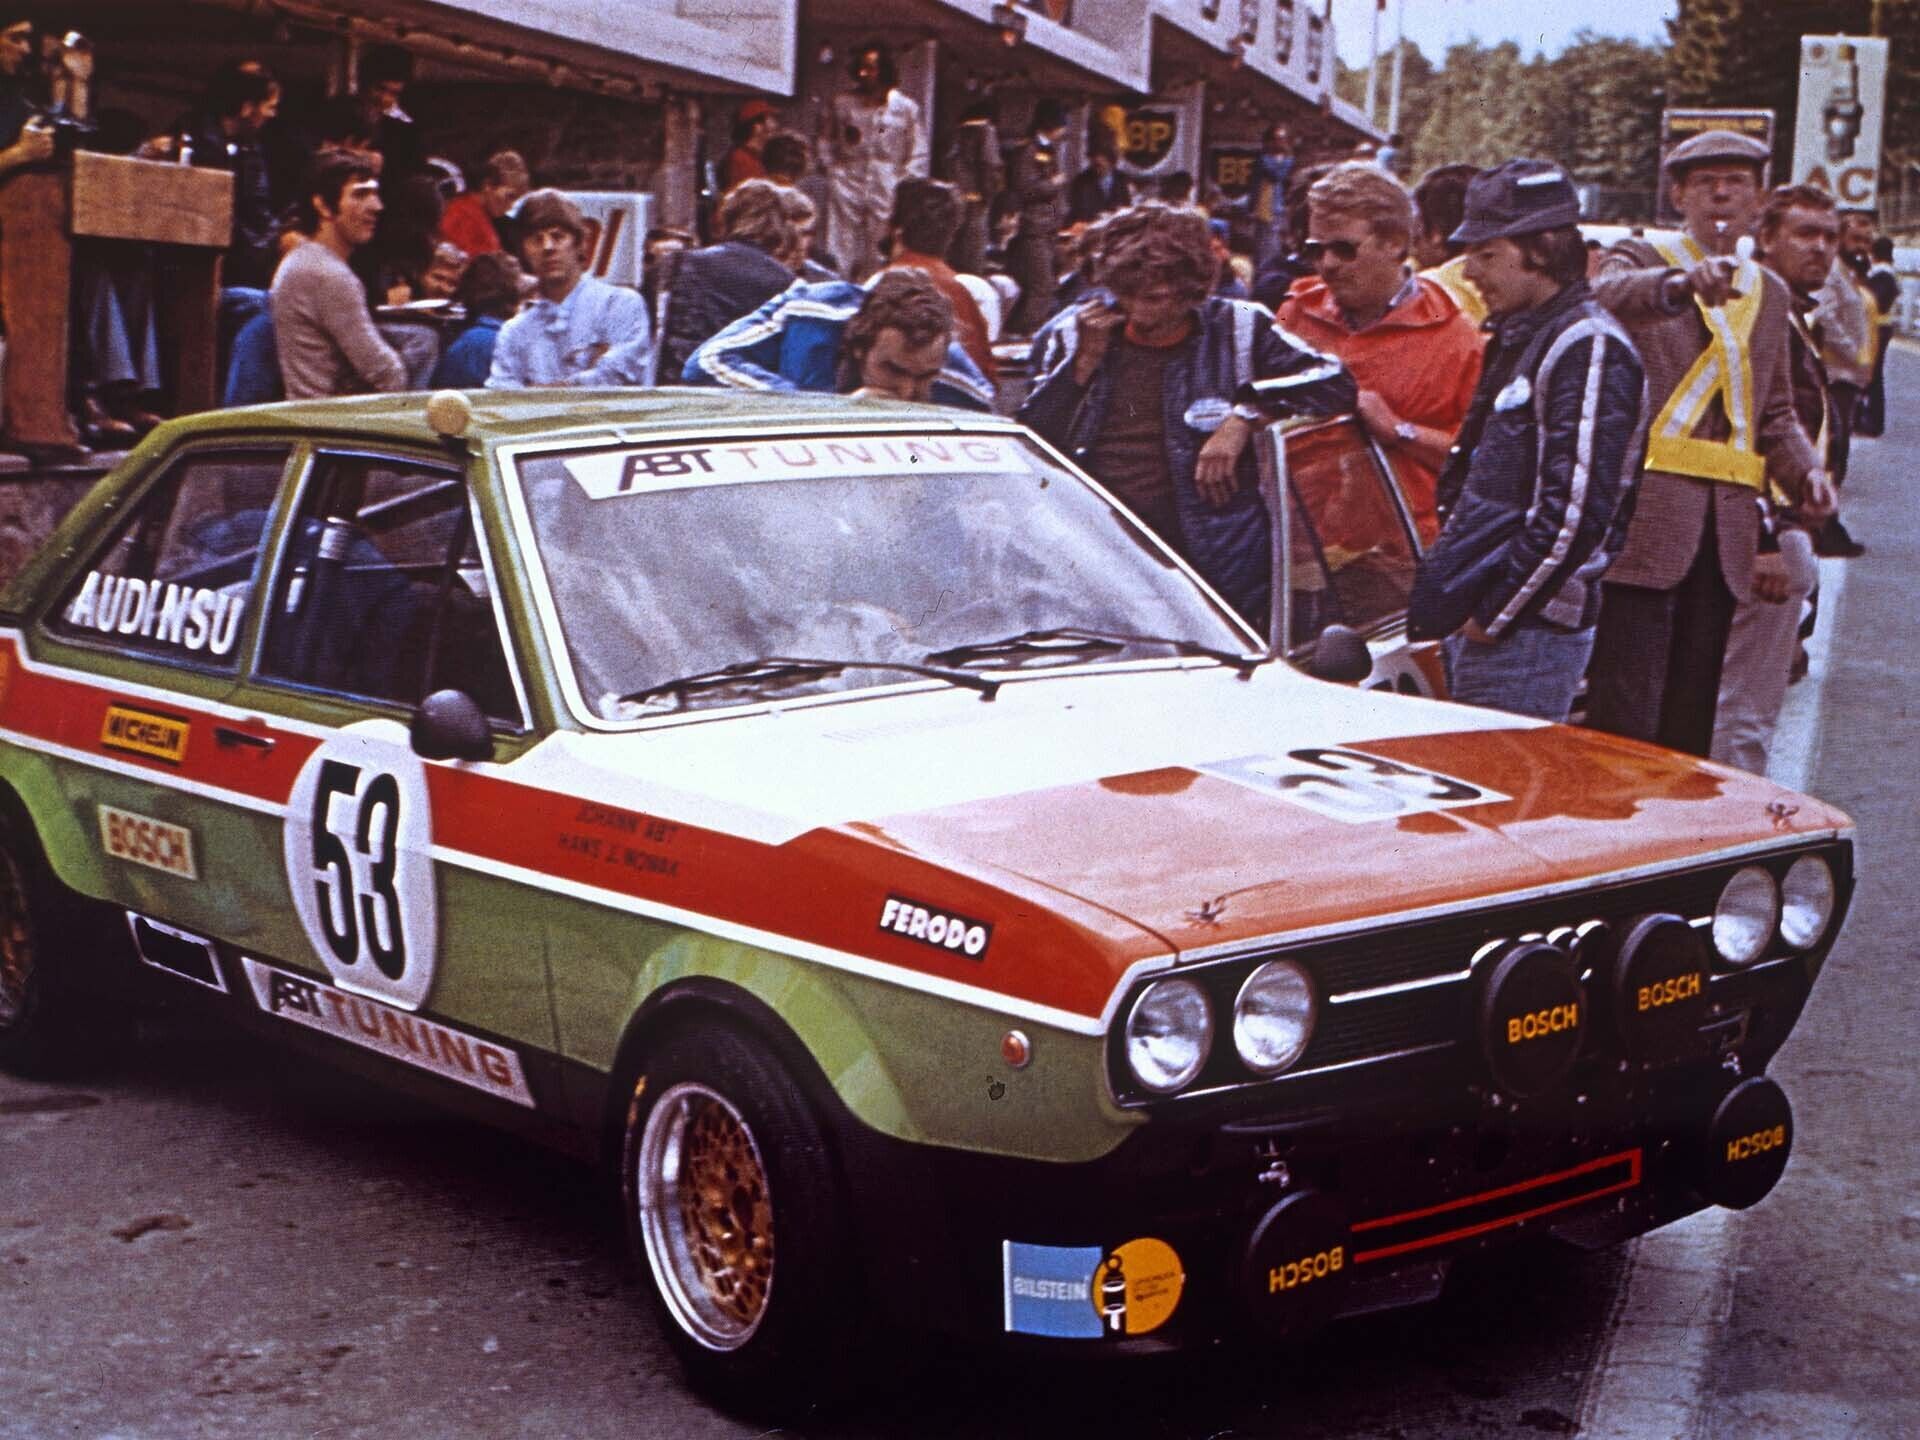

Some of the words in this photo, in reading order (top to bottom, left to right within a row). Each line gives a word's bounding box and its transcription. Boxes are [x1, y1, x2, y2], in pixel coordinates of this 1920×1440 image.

[1130, 119, 1171, 151] BP
[618, 449, 714, 491] ABT
[725, 442, 1002, 469] TUNING
[107, 812, 189, 873] BOSCH
[312, 758, 407, 981] 53
[880, 899, 986, 955] FERODO
[1637, 973, 1701, 1012] BOSCH
[270, 970, 324, 1017] ABT
[324, 989, 513, 1086] TUNING
[1508, 1003, 1578, 1044] BOSCH
[1727, 1124, 1785, 1162] BOSCH
[1013, 1275, 1090, 1301] BILSTEIN
[1269, 1245, 1343, 1294] BOSCH
